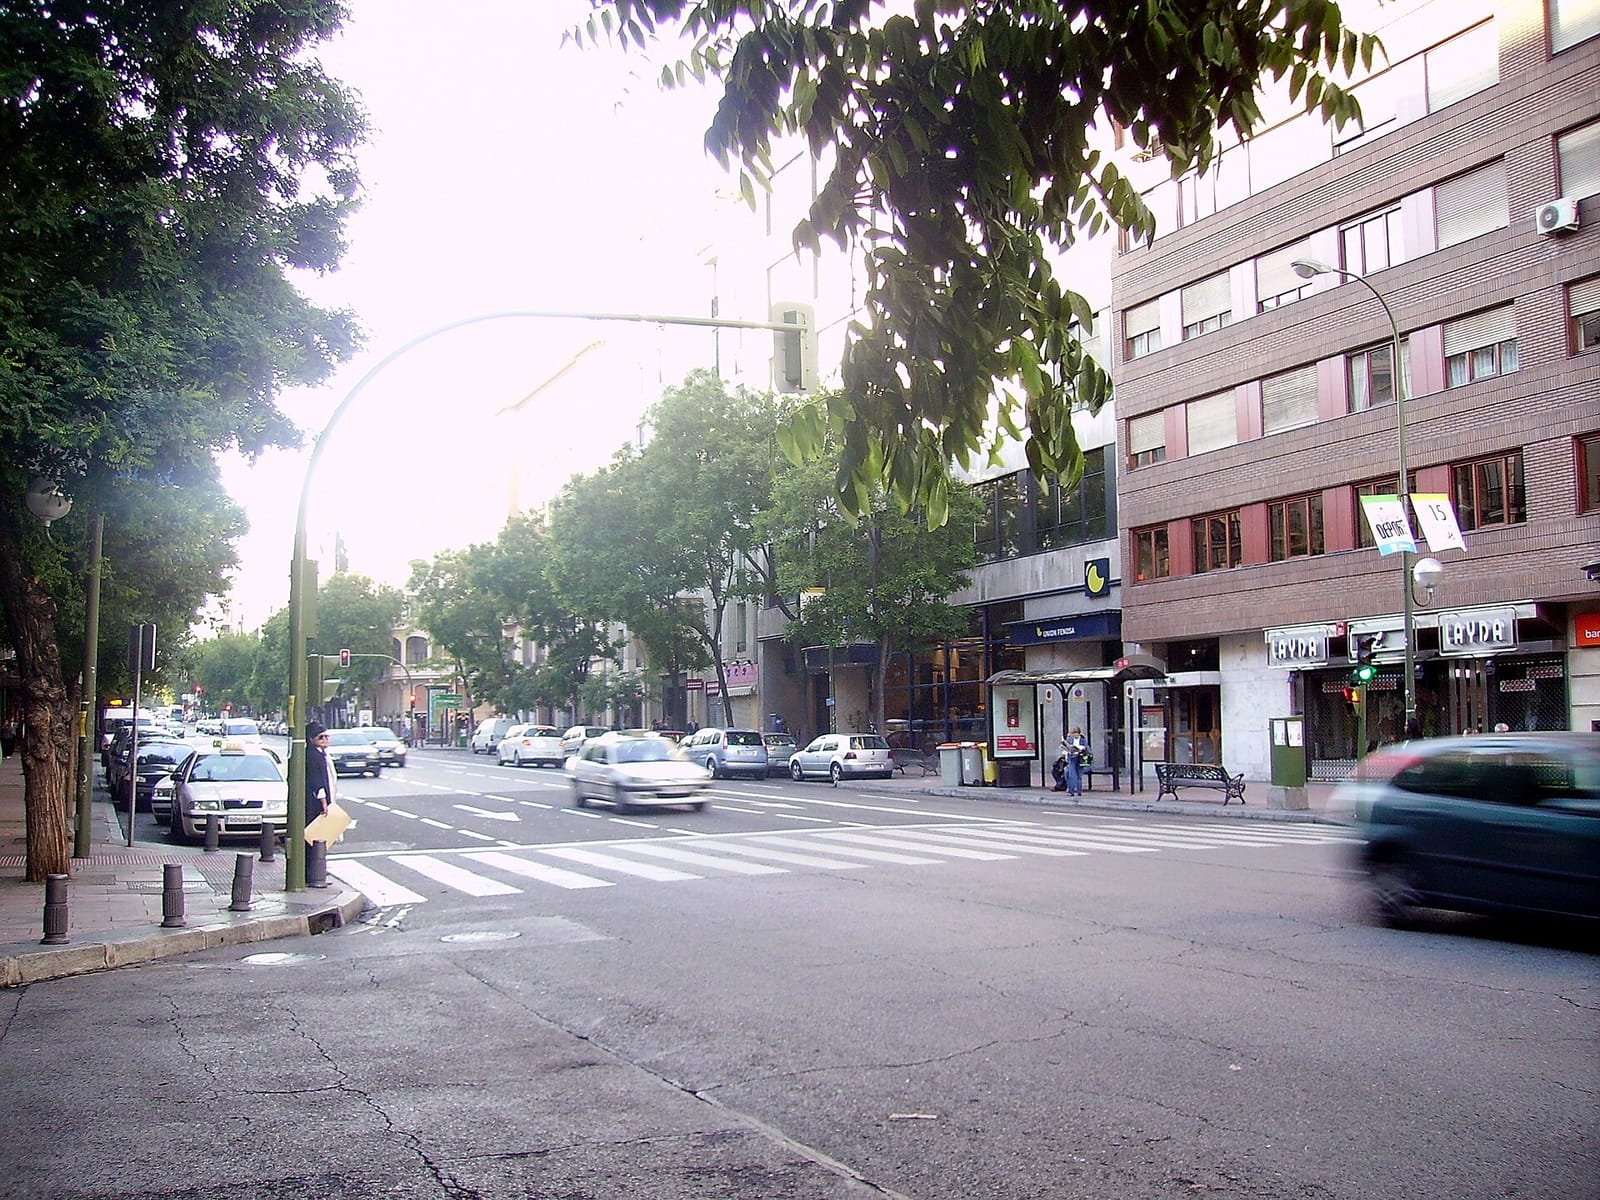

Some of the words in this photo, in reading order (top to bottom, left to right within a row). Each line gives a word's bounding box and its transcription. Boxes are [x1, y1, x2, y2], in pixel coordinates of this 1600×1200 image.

[1428, 504, 1447, 521] 15
[1446, 618, 1503, 645] LAYDA
[1272, 636, 1317, 659] LAYDA
